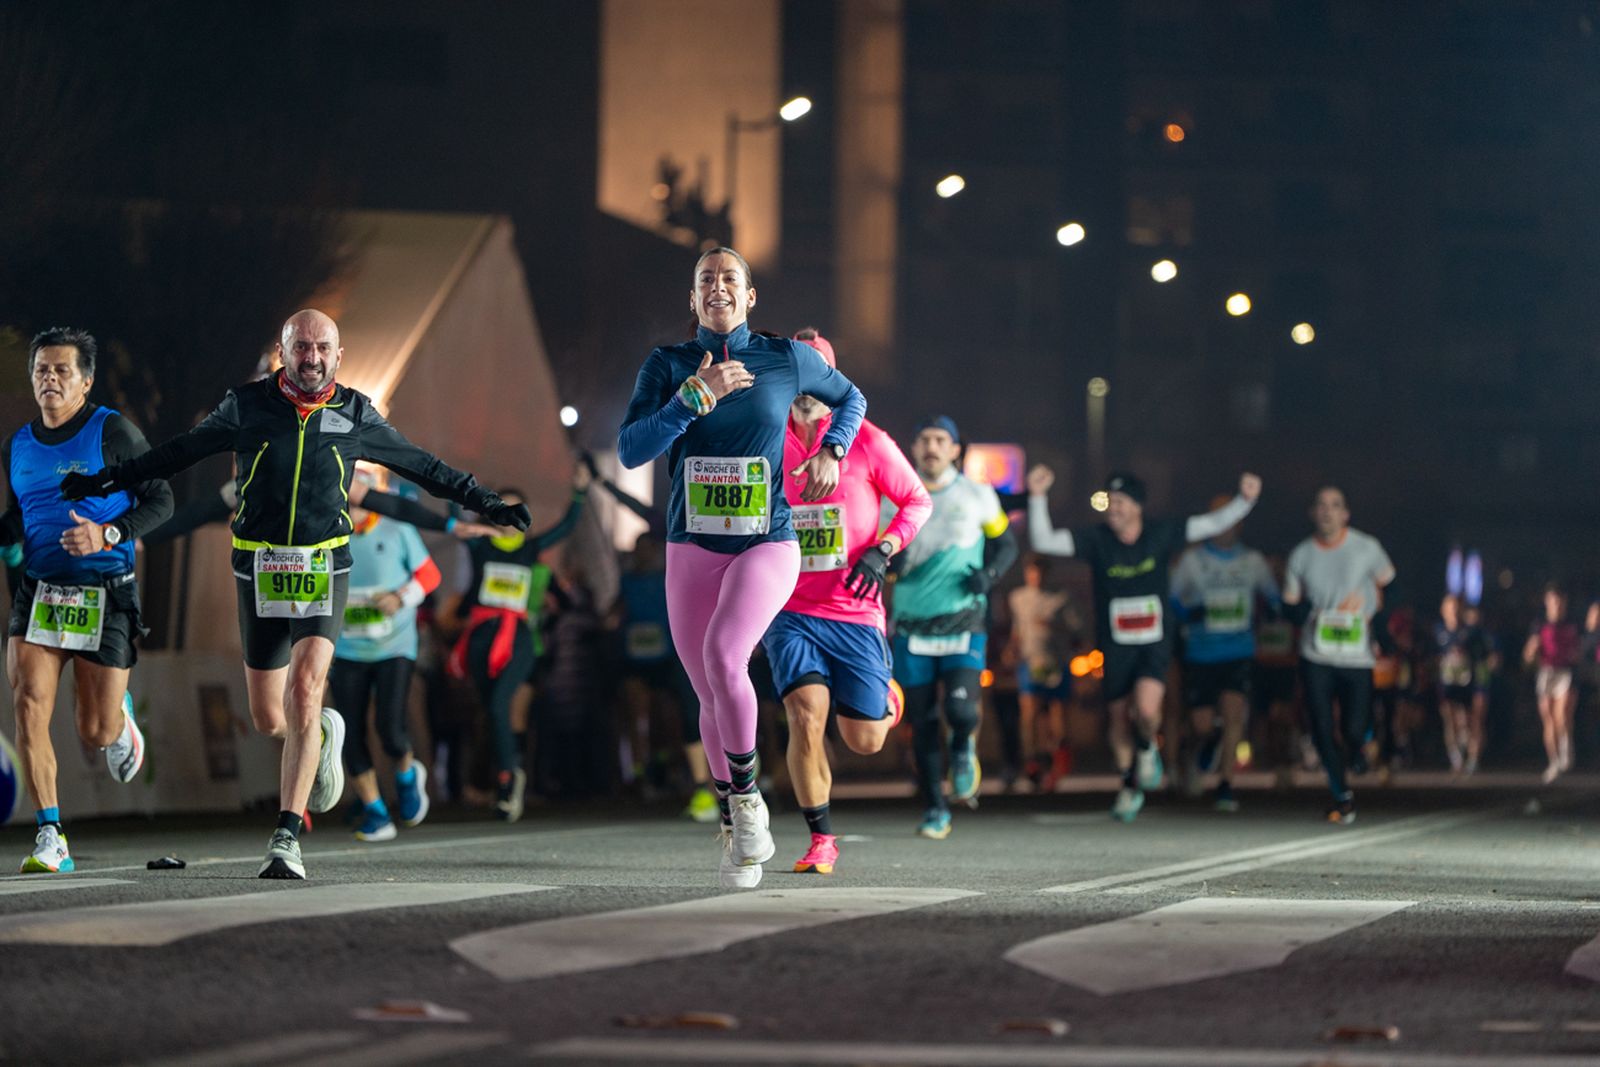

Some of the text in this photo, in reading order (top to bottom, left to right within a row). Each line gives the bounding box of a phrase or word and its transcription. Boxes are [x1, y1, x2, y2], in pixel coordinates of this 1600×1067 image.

[694, 474, 710, 482] SAN
[703, 485, 753, 508] 7887
[796, 528, 836, 549] 2267
[263, 563, 277, 571] SAN
[272, 573, 316, 594] 9176
